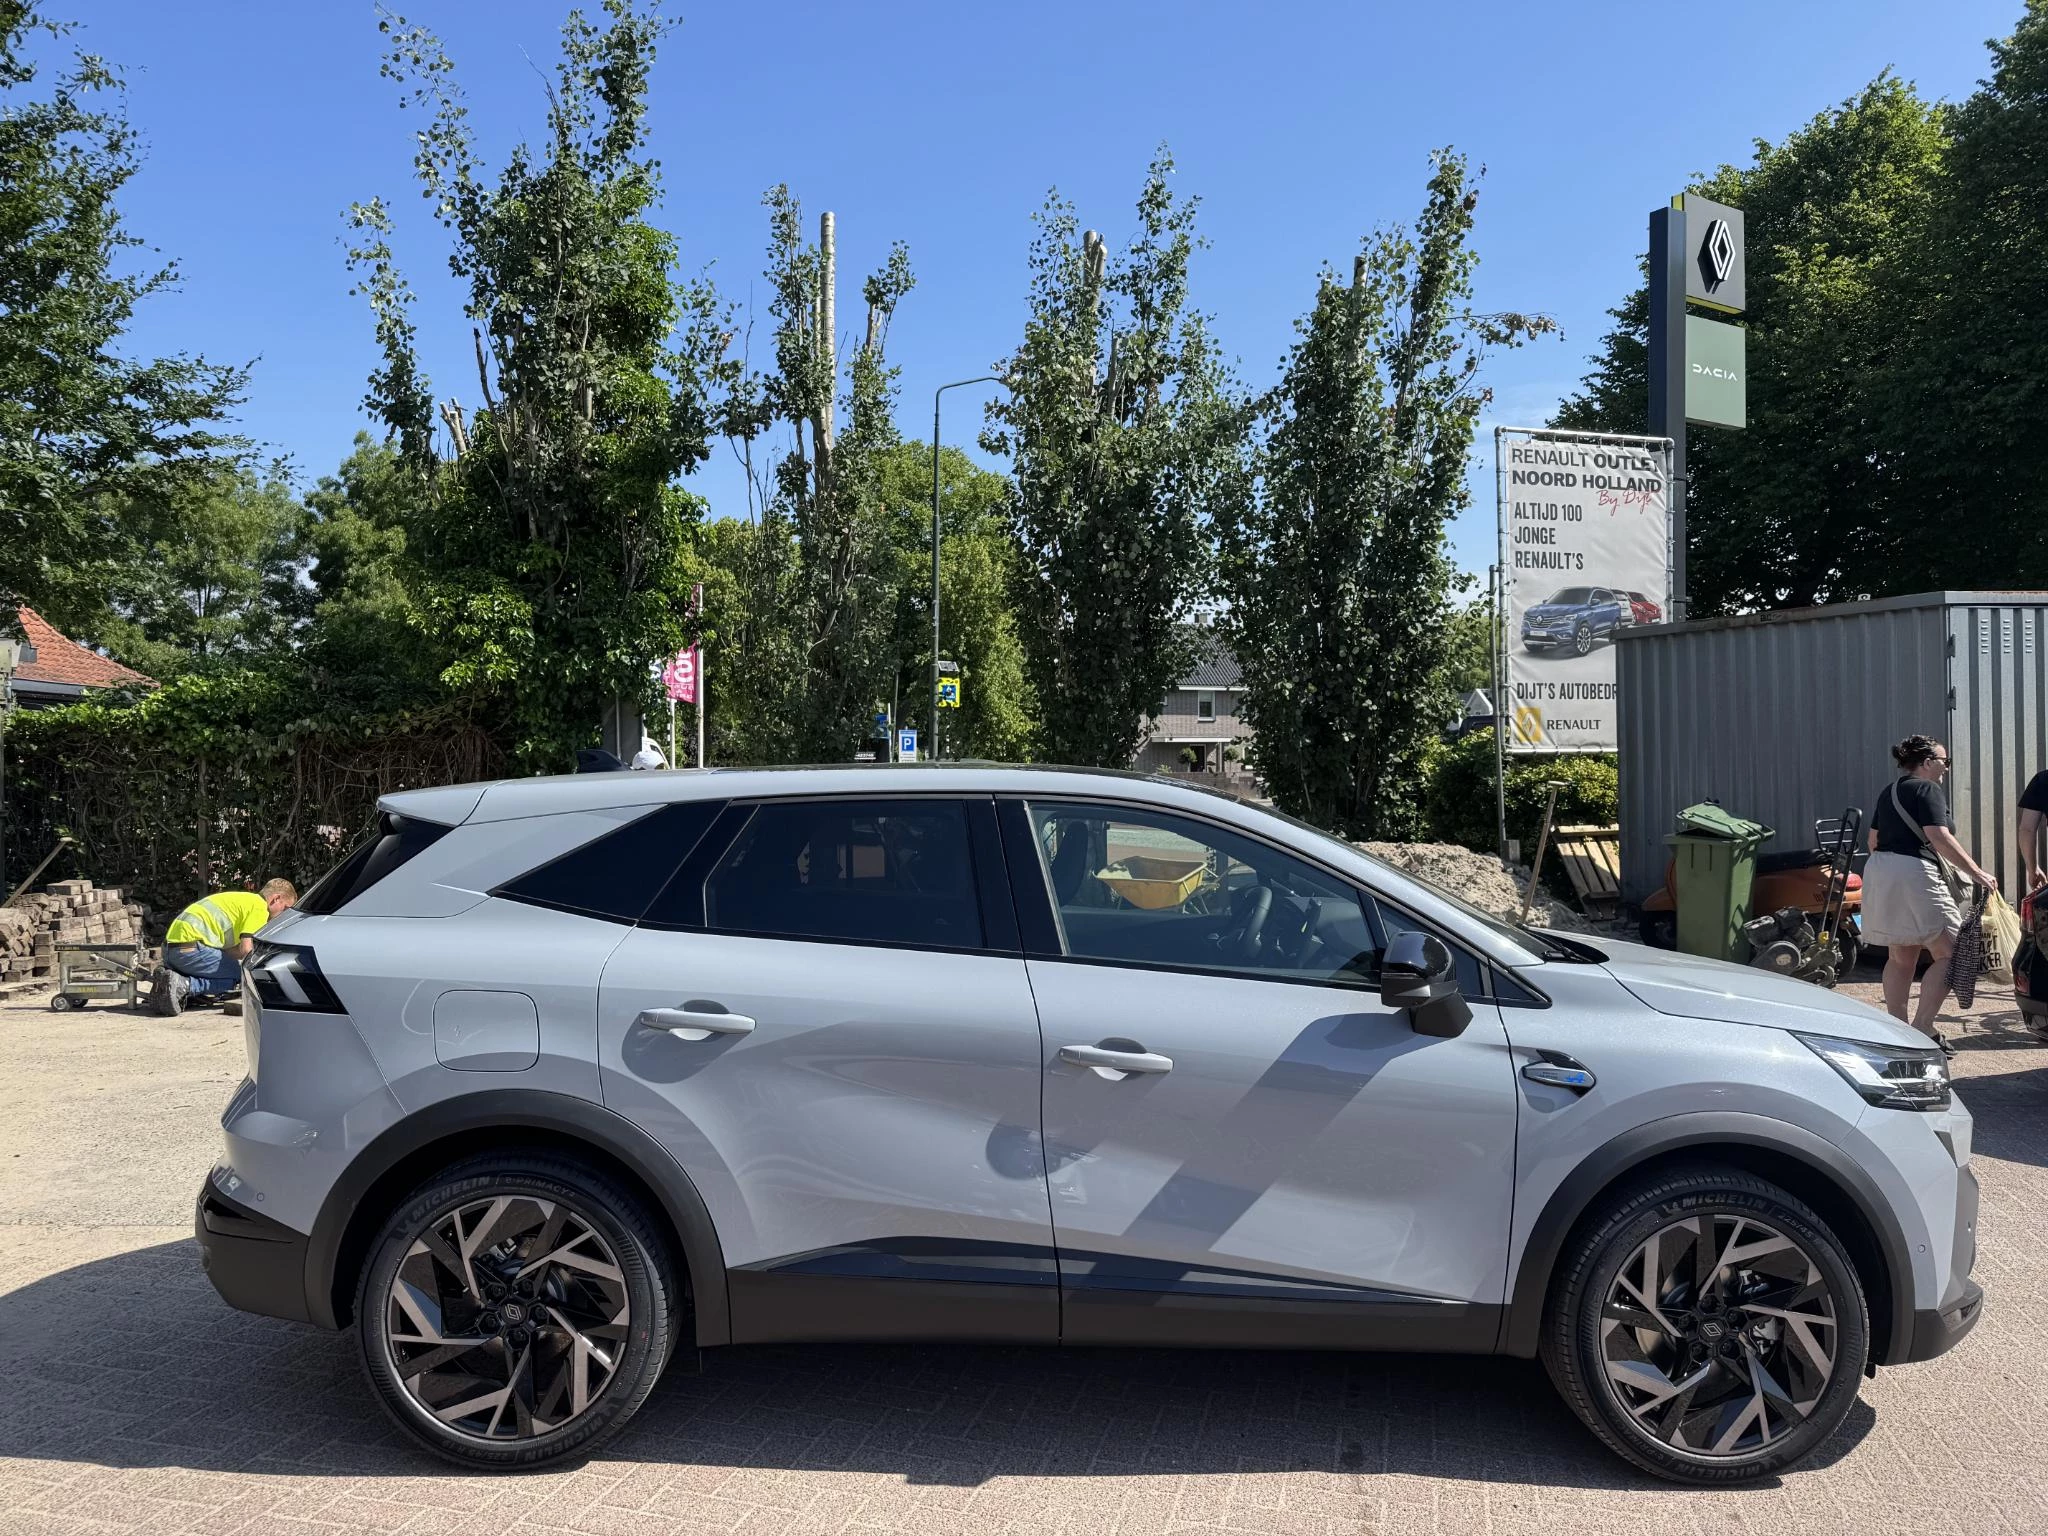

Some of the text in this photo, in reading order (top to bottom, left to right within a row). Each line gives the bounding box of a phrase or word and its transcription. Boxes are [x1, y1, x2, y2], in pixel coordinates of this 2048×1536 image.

[1692, 363, 1737, 381] DACIA
[1512, 448, 1588, 467] RENAULT
[1512, 470, 1662, 493] NOORD HOLLAND
[1514, 502, 1582, 522] ALTIJD 100
[1596, 489, 1620, 516] By
[1514, 526, 1556, 545] JONGE
[1515, 550, 1584, 570] RENAULT'S
[1516, 682, 1556, 700] DIJT'S
[1546, 719, 1602, 731] RENAULT
[412, 1176, 490, 1220] MICHELIN
[1682, 1193, 1767, 1209] MICHELIN
